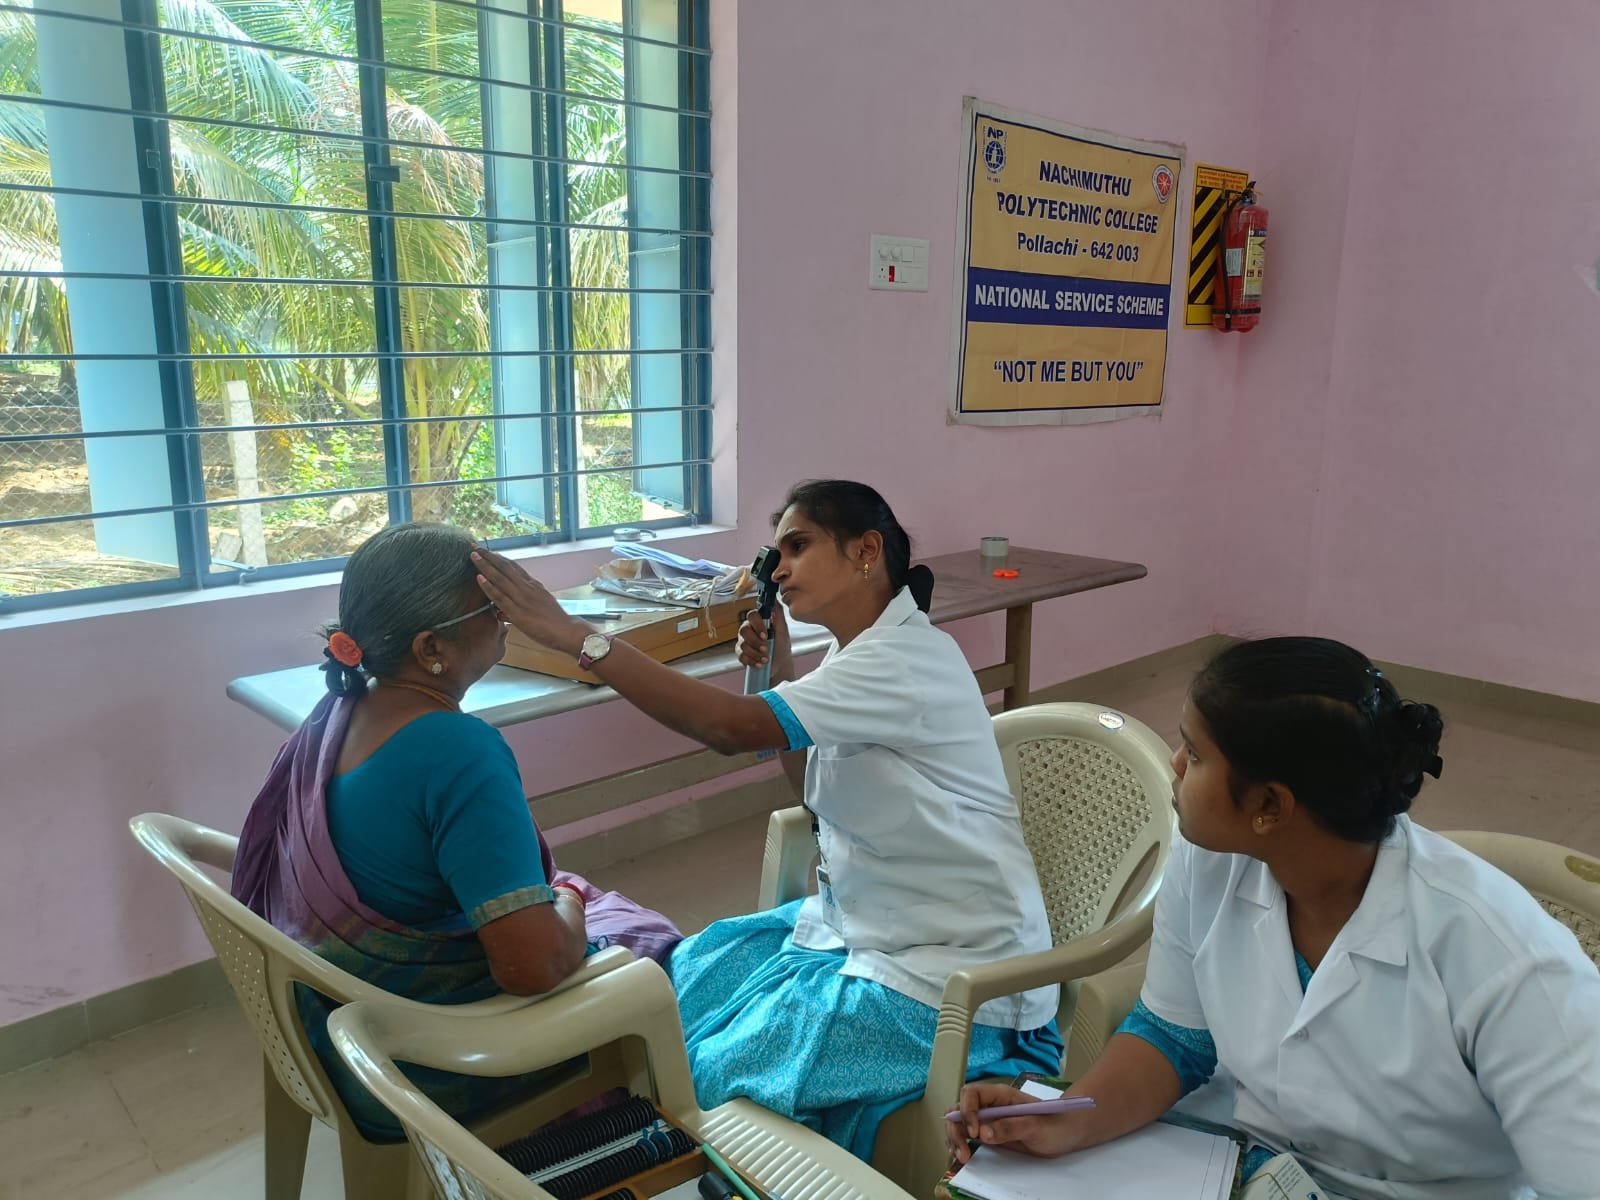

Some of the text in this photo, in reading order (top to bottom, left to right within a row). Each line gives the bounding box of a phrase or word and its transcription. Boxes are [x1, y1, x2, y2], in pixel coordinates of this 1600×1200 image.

[987, 127, 1004, 140] NP
[1040, 160, 1132, 196] NACHIMUTHU
[997, 192, 1158, 233] POLYTECHNIC COLLEGE
[1018, 232, 1079, 256] Pollachi
[1091, 241, 1112, 260] 642
[1116, 244, 1139, 262] 003
[975, 284, 1164, 316] NATIONAL SERVICE SCHEME
[994, 361, 1144, 383] “NOT ME BUT YOU”
